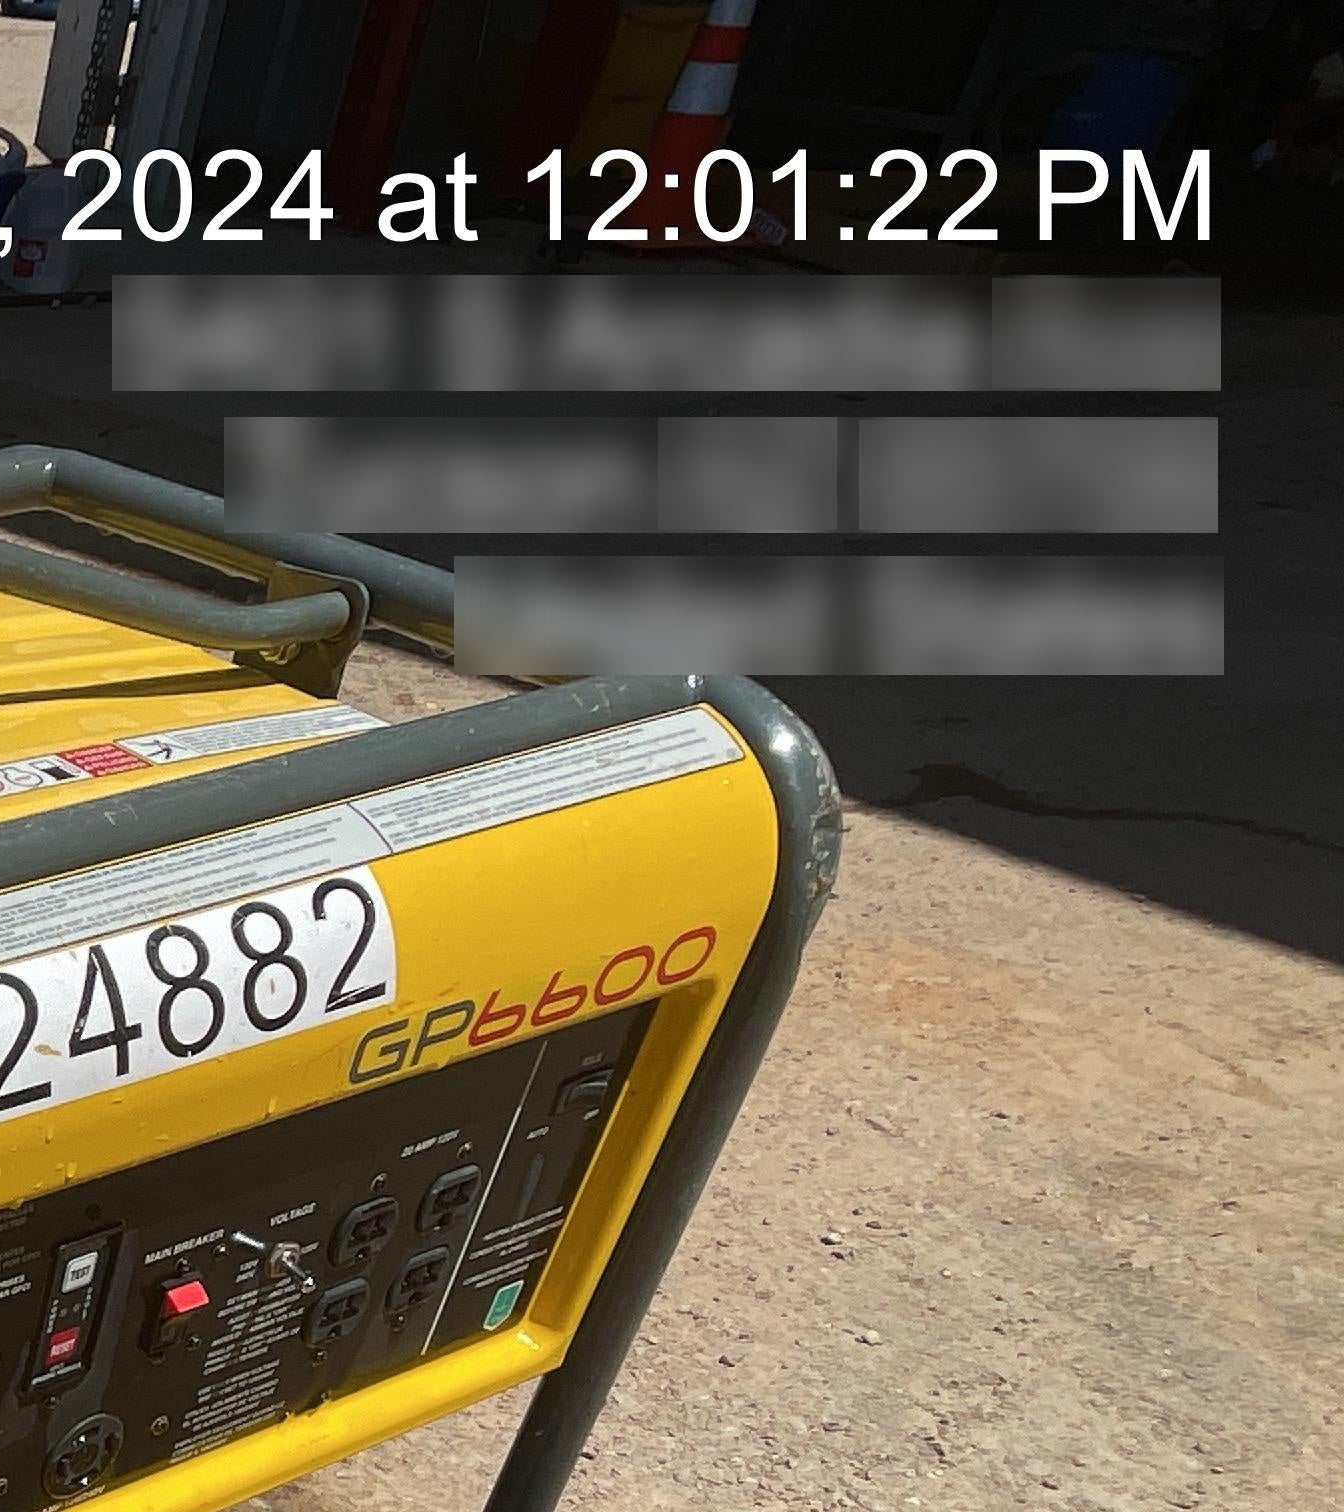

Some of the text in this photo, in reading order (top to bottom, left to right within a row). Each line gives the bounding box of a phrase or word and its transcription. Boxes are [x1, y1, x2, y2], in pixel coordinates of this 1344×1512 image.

[348, 925, 718, 1085] GP6600
[270, 1202, 317, 1227] VOLTAGE
[144, 1229, 225, 1265] MAIN BREAKER
